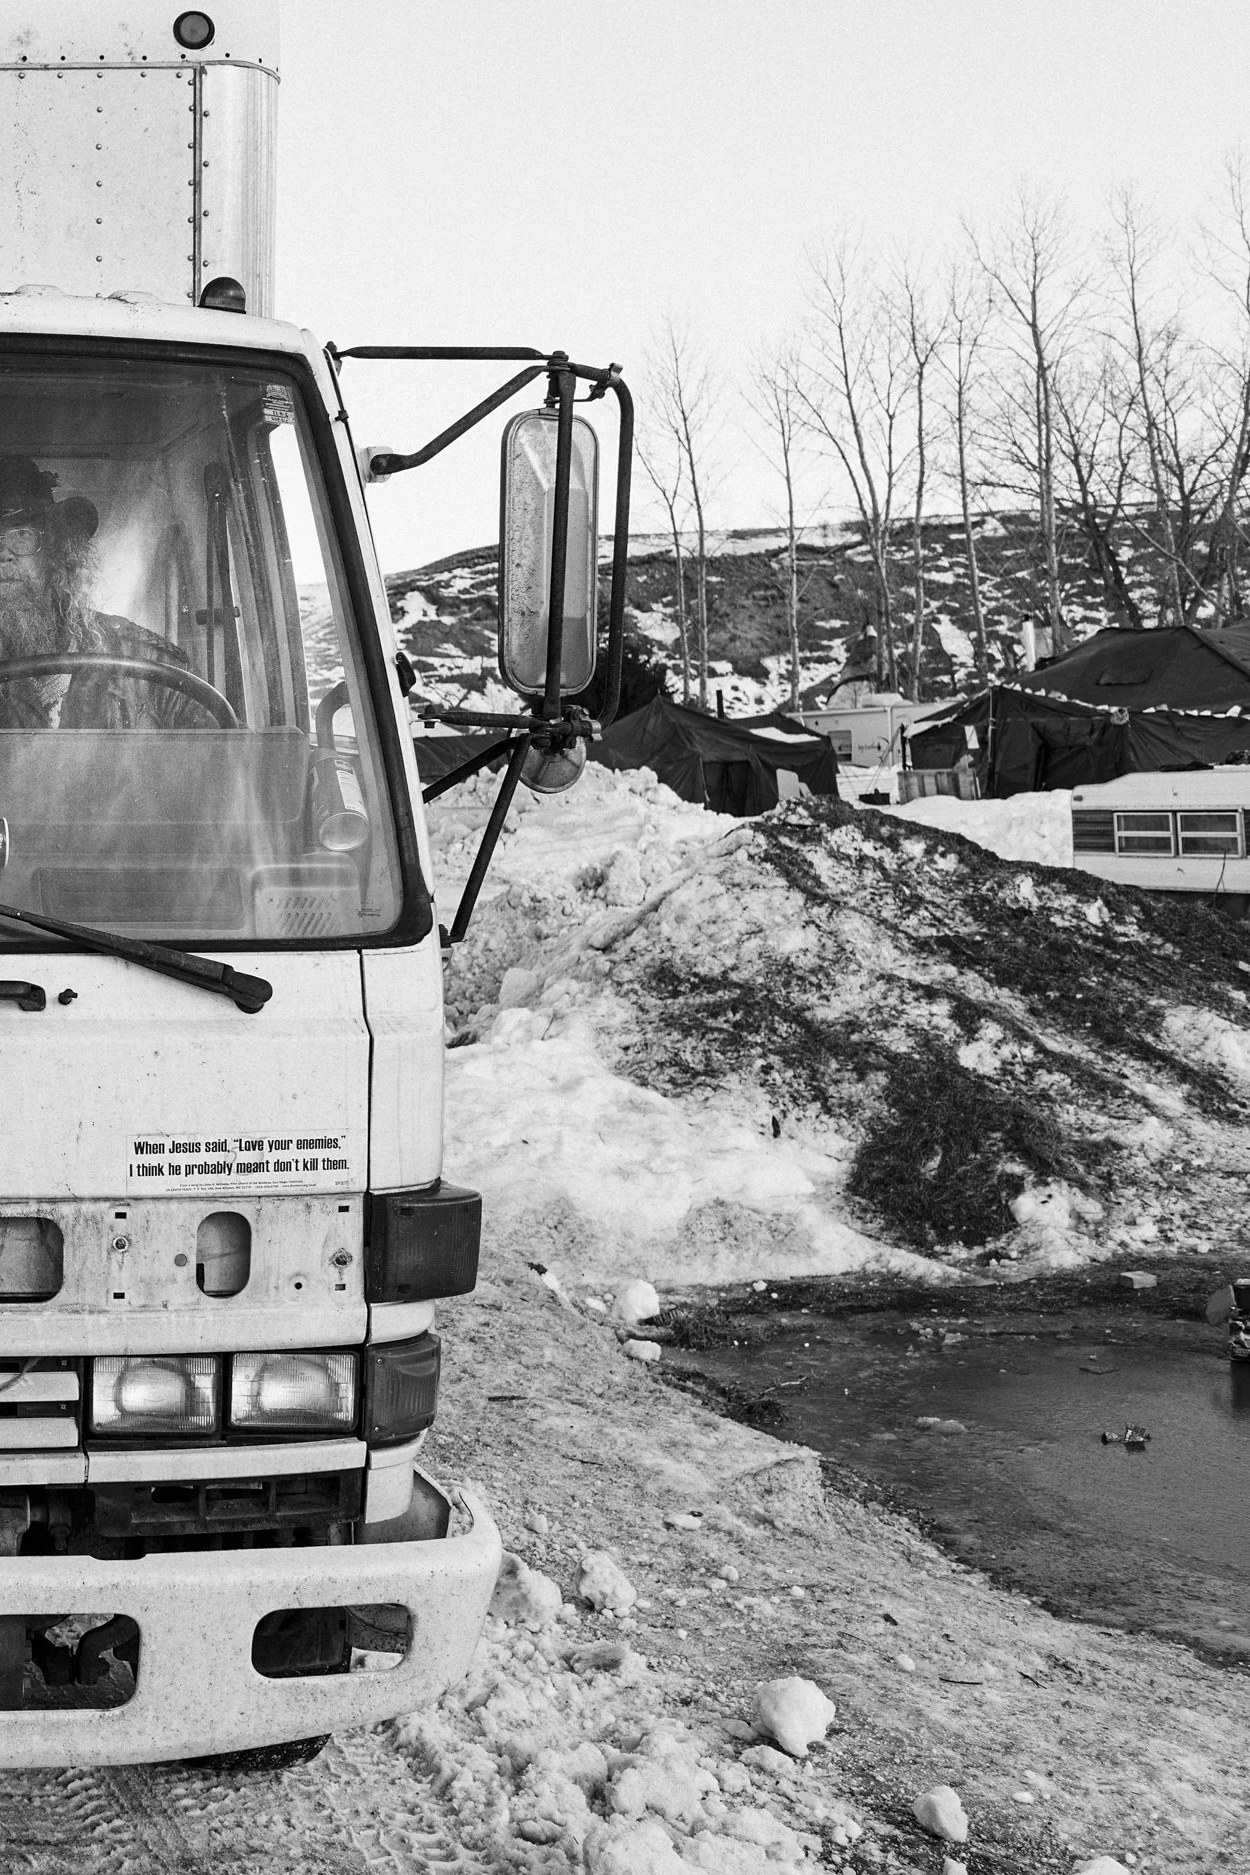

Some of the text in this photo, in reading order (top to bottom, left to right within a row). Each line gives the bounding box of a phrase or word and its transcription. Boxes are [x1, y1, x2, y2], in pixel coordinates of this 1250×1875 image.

[134, 1141, 165, 1155] When
[168, 1140, 201, 1154] Jesus
[204, 1139, 230, 1153] said,
[267, 1139, 293, 1153] your
[129, 1157, 350, 1177] I think he probably meant don't kill them.
